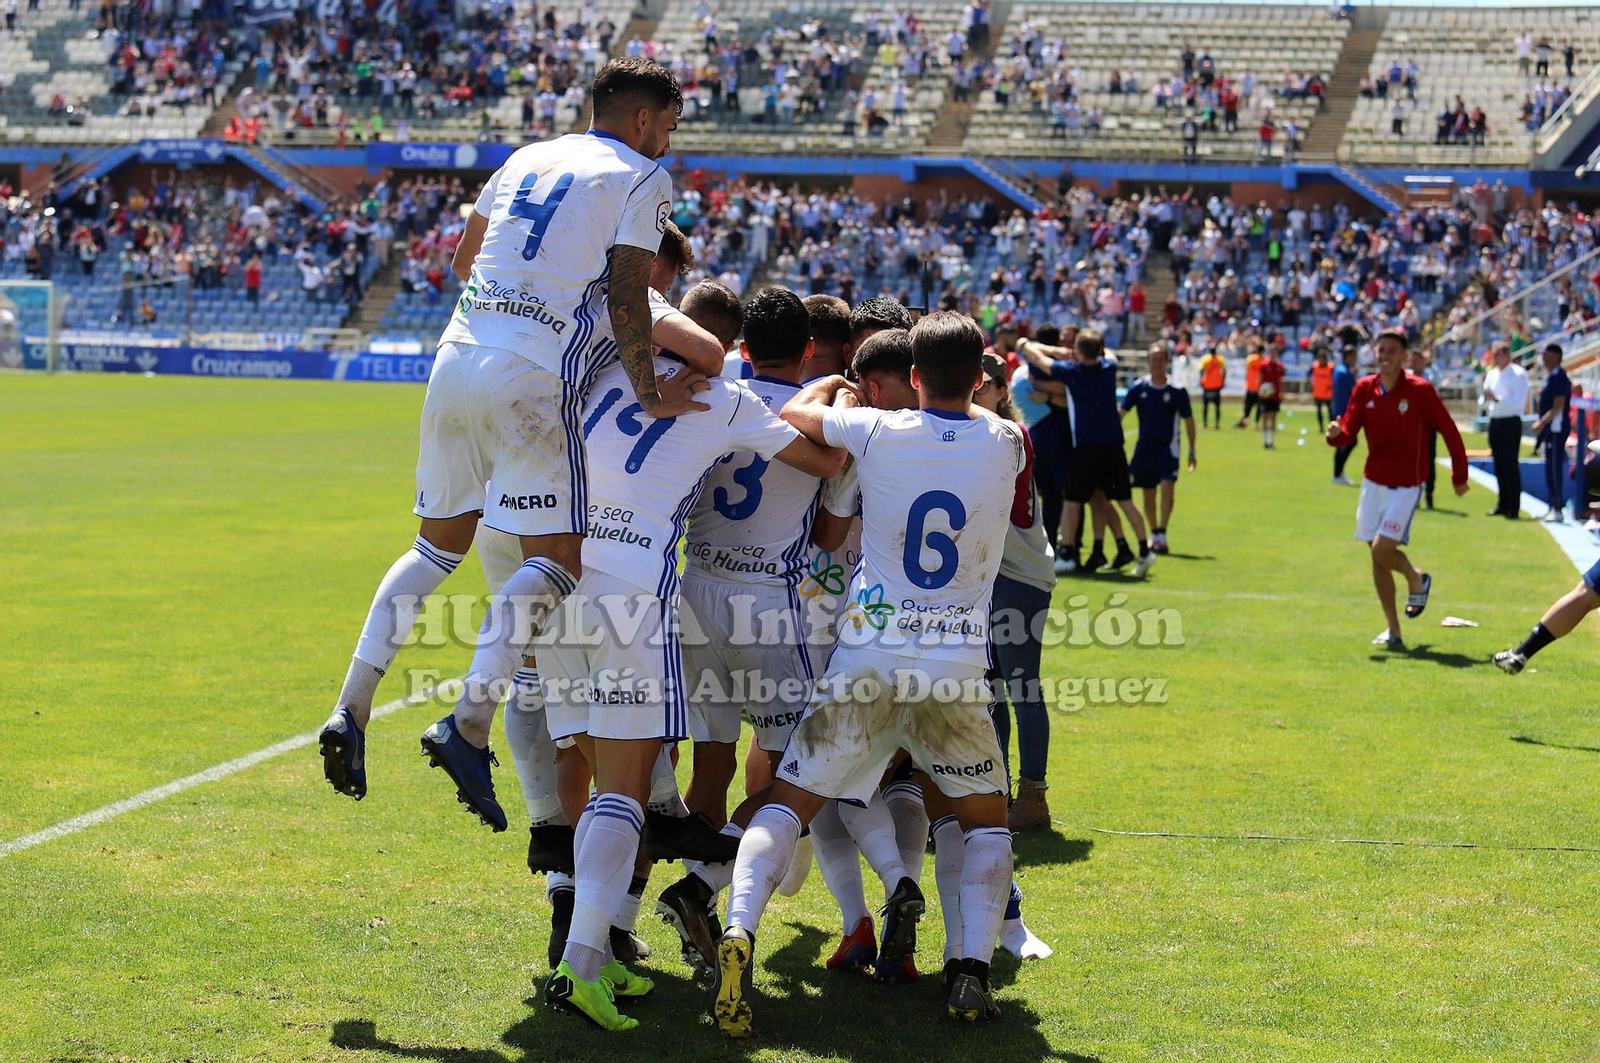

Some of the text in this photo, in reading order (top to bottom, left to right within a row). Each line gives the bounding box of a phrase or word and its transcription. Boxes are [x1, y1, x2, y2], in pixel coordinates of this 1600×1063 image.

[509, 172, 575, 262] 4
[482, 280, 515, 300] Que
[496, 301, 566, 335] Huelva
[191, 353, 292, 377] Cruzcampo
[584, 388, 677, 474] 19
[714, 452, 770, 520] 3
[499, 494, 557, 510] RMERO
[600, 507, 634, 523] sea
[588, 522, 652, 549] Huelva
[902, 490, 966, 590] 6
[712, 550, 777, 575] Huva
[897, 614, 921, 632] de
